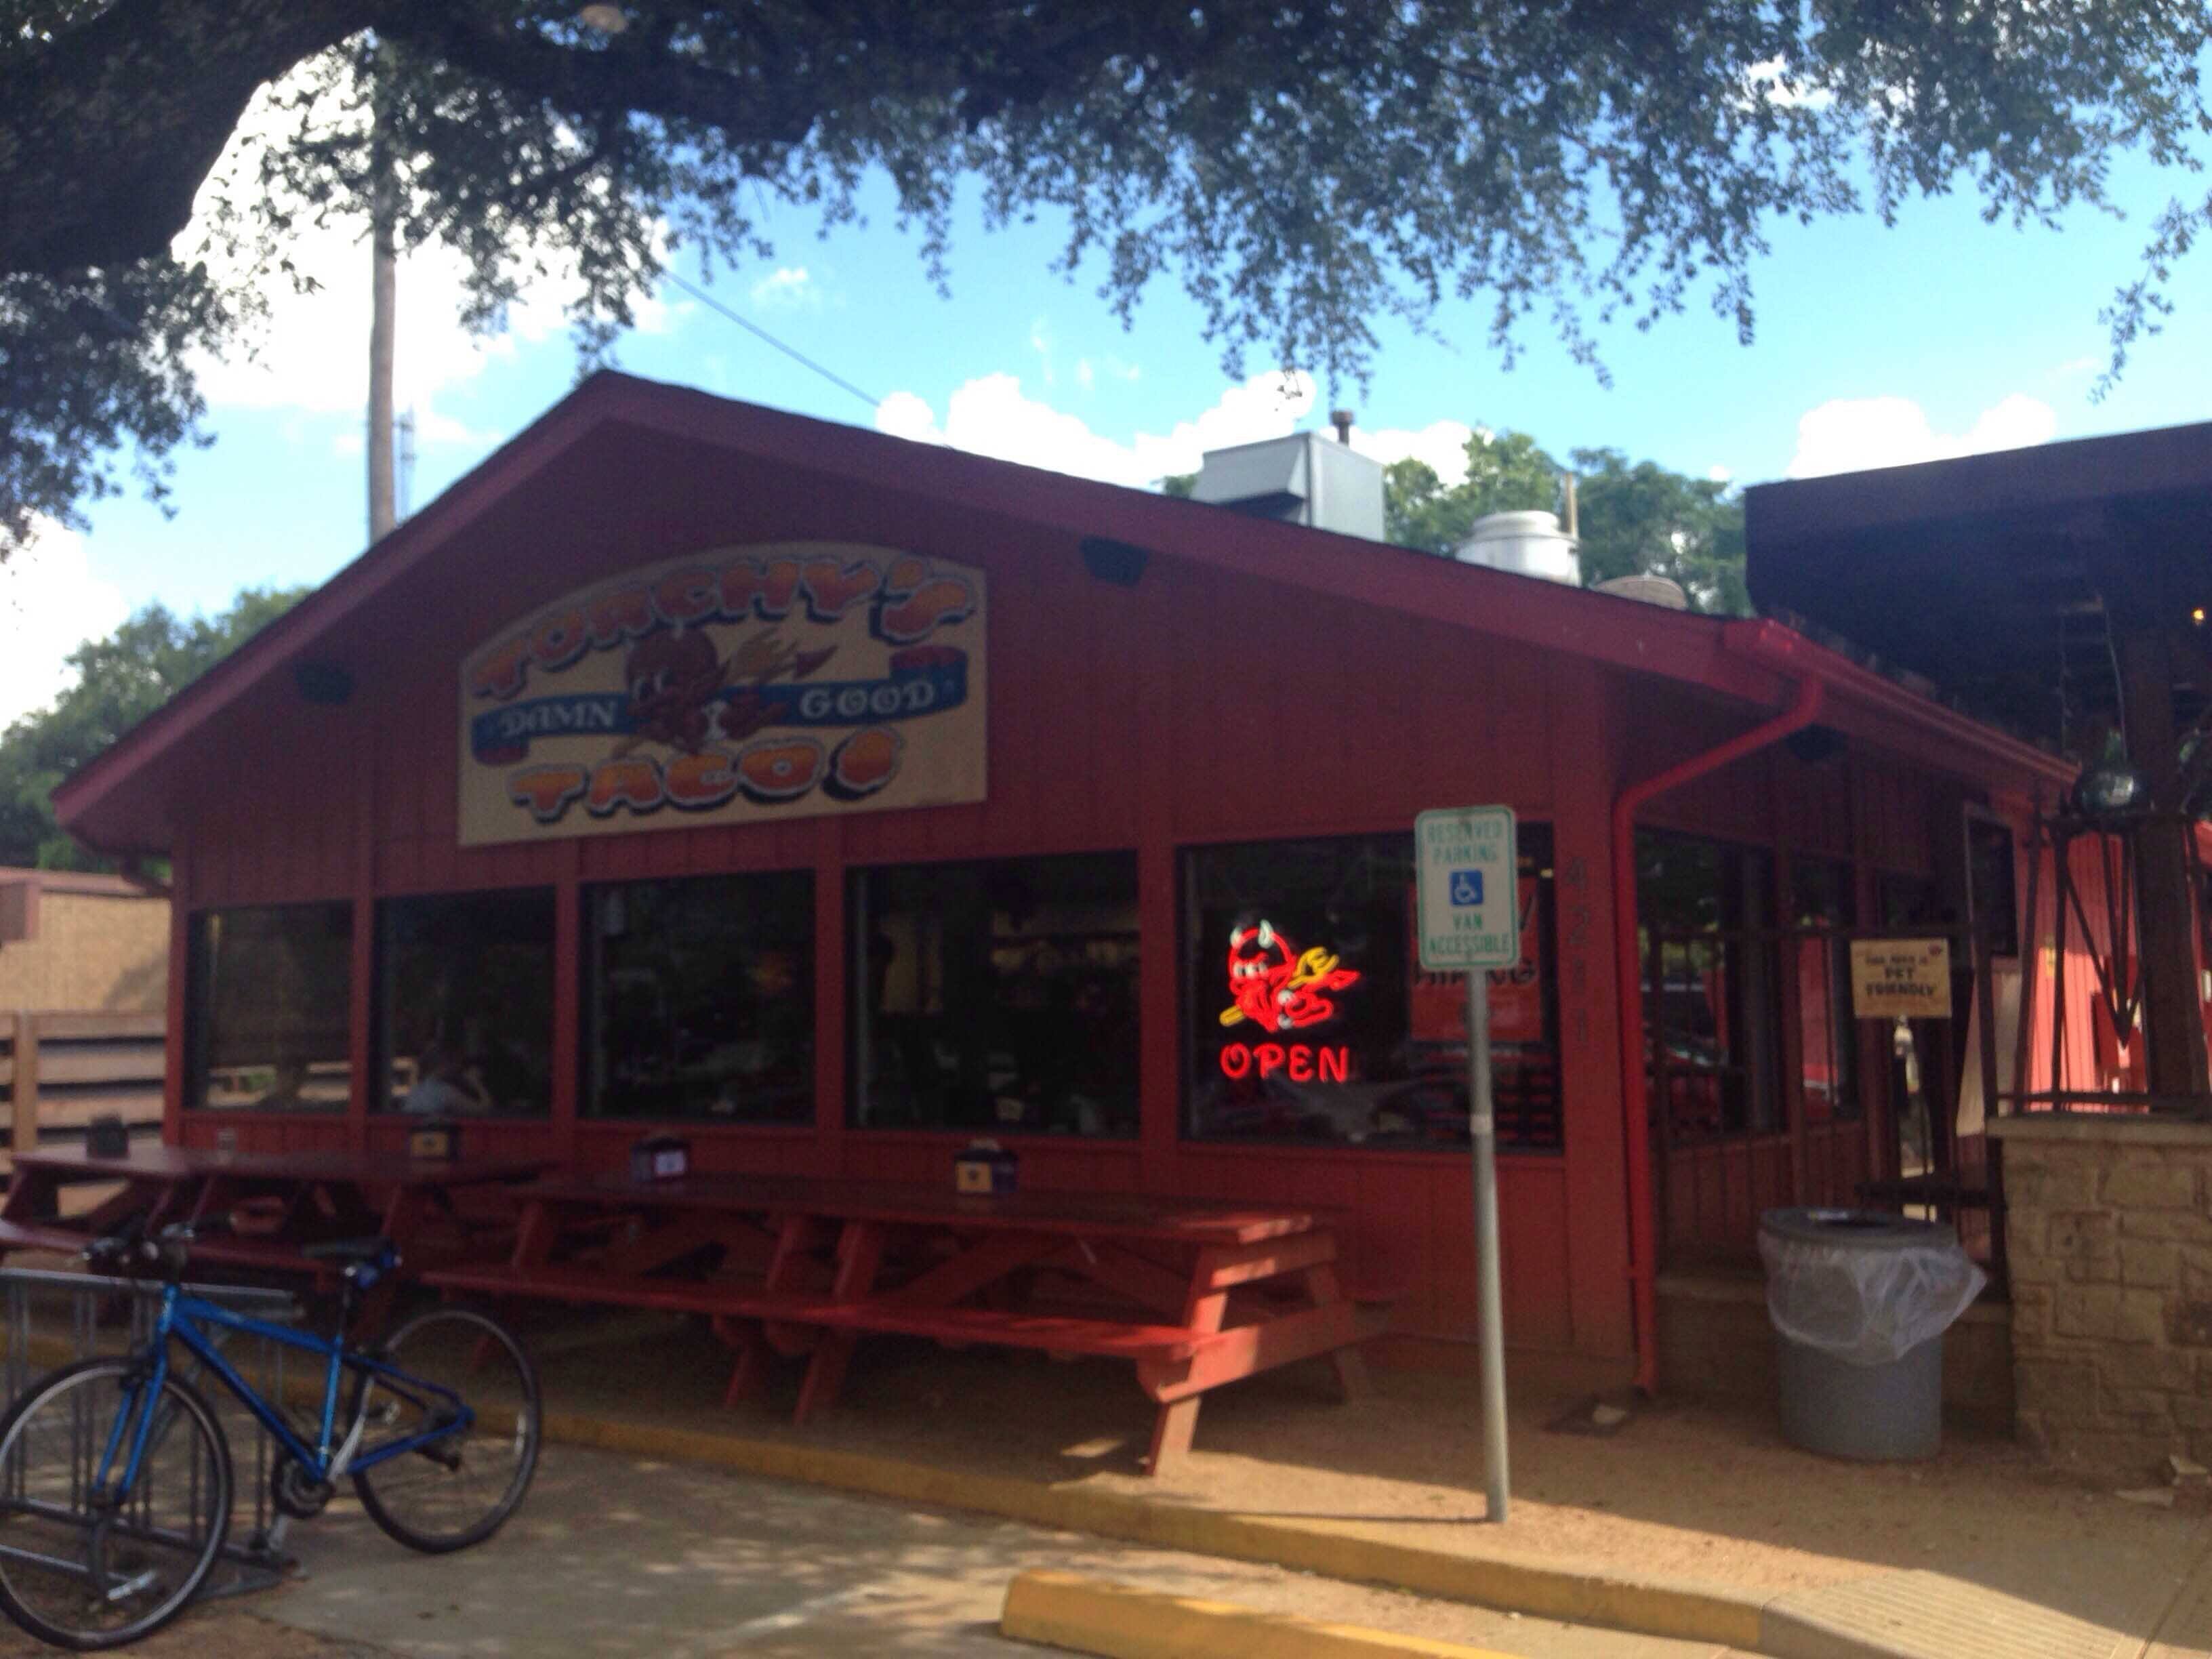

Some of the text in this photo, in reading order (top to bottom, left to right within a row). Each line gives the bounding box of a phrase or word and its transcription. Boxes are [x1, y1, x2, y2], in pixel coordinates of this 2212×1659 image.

[474, 556, 976, 698] TORCHY'S
[499, 680, 938, 738] DAMN GOOD
[510, 725, 903, 825] TACOS
[1427, 820, 1502, 842] RESERVED
[1432, 844, 1497, 864] PARKING
[1452, 914, 1483, 931] VAN
[1429, 933, 1510, 955] ACCESSIBLE
[1885, 966, 1914, 980] PET
[1220, 1042, 1350, 1083] OPEN
